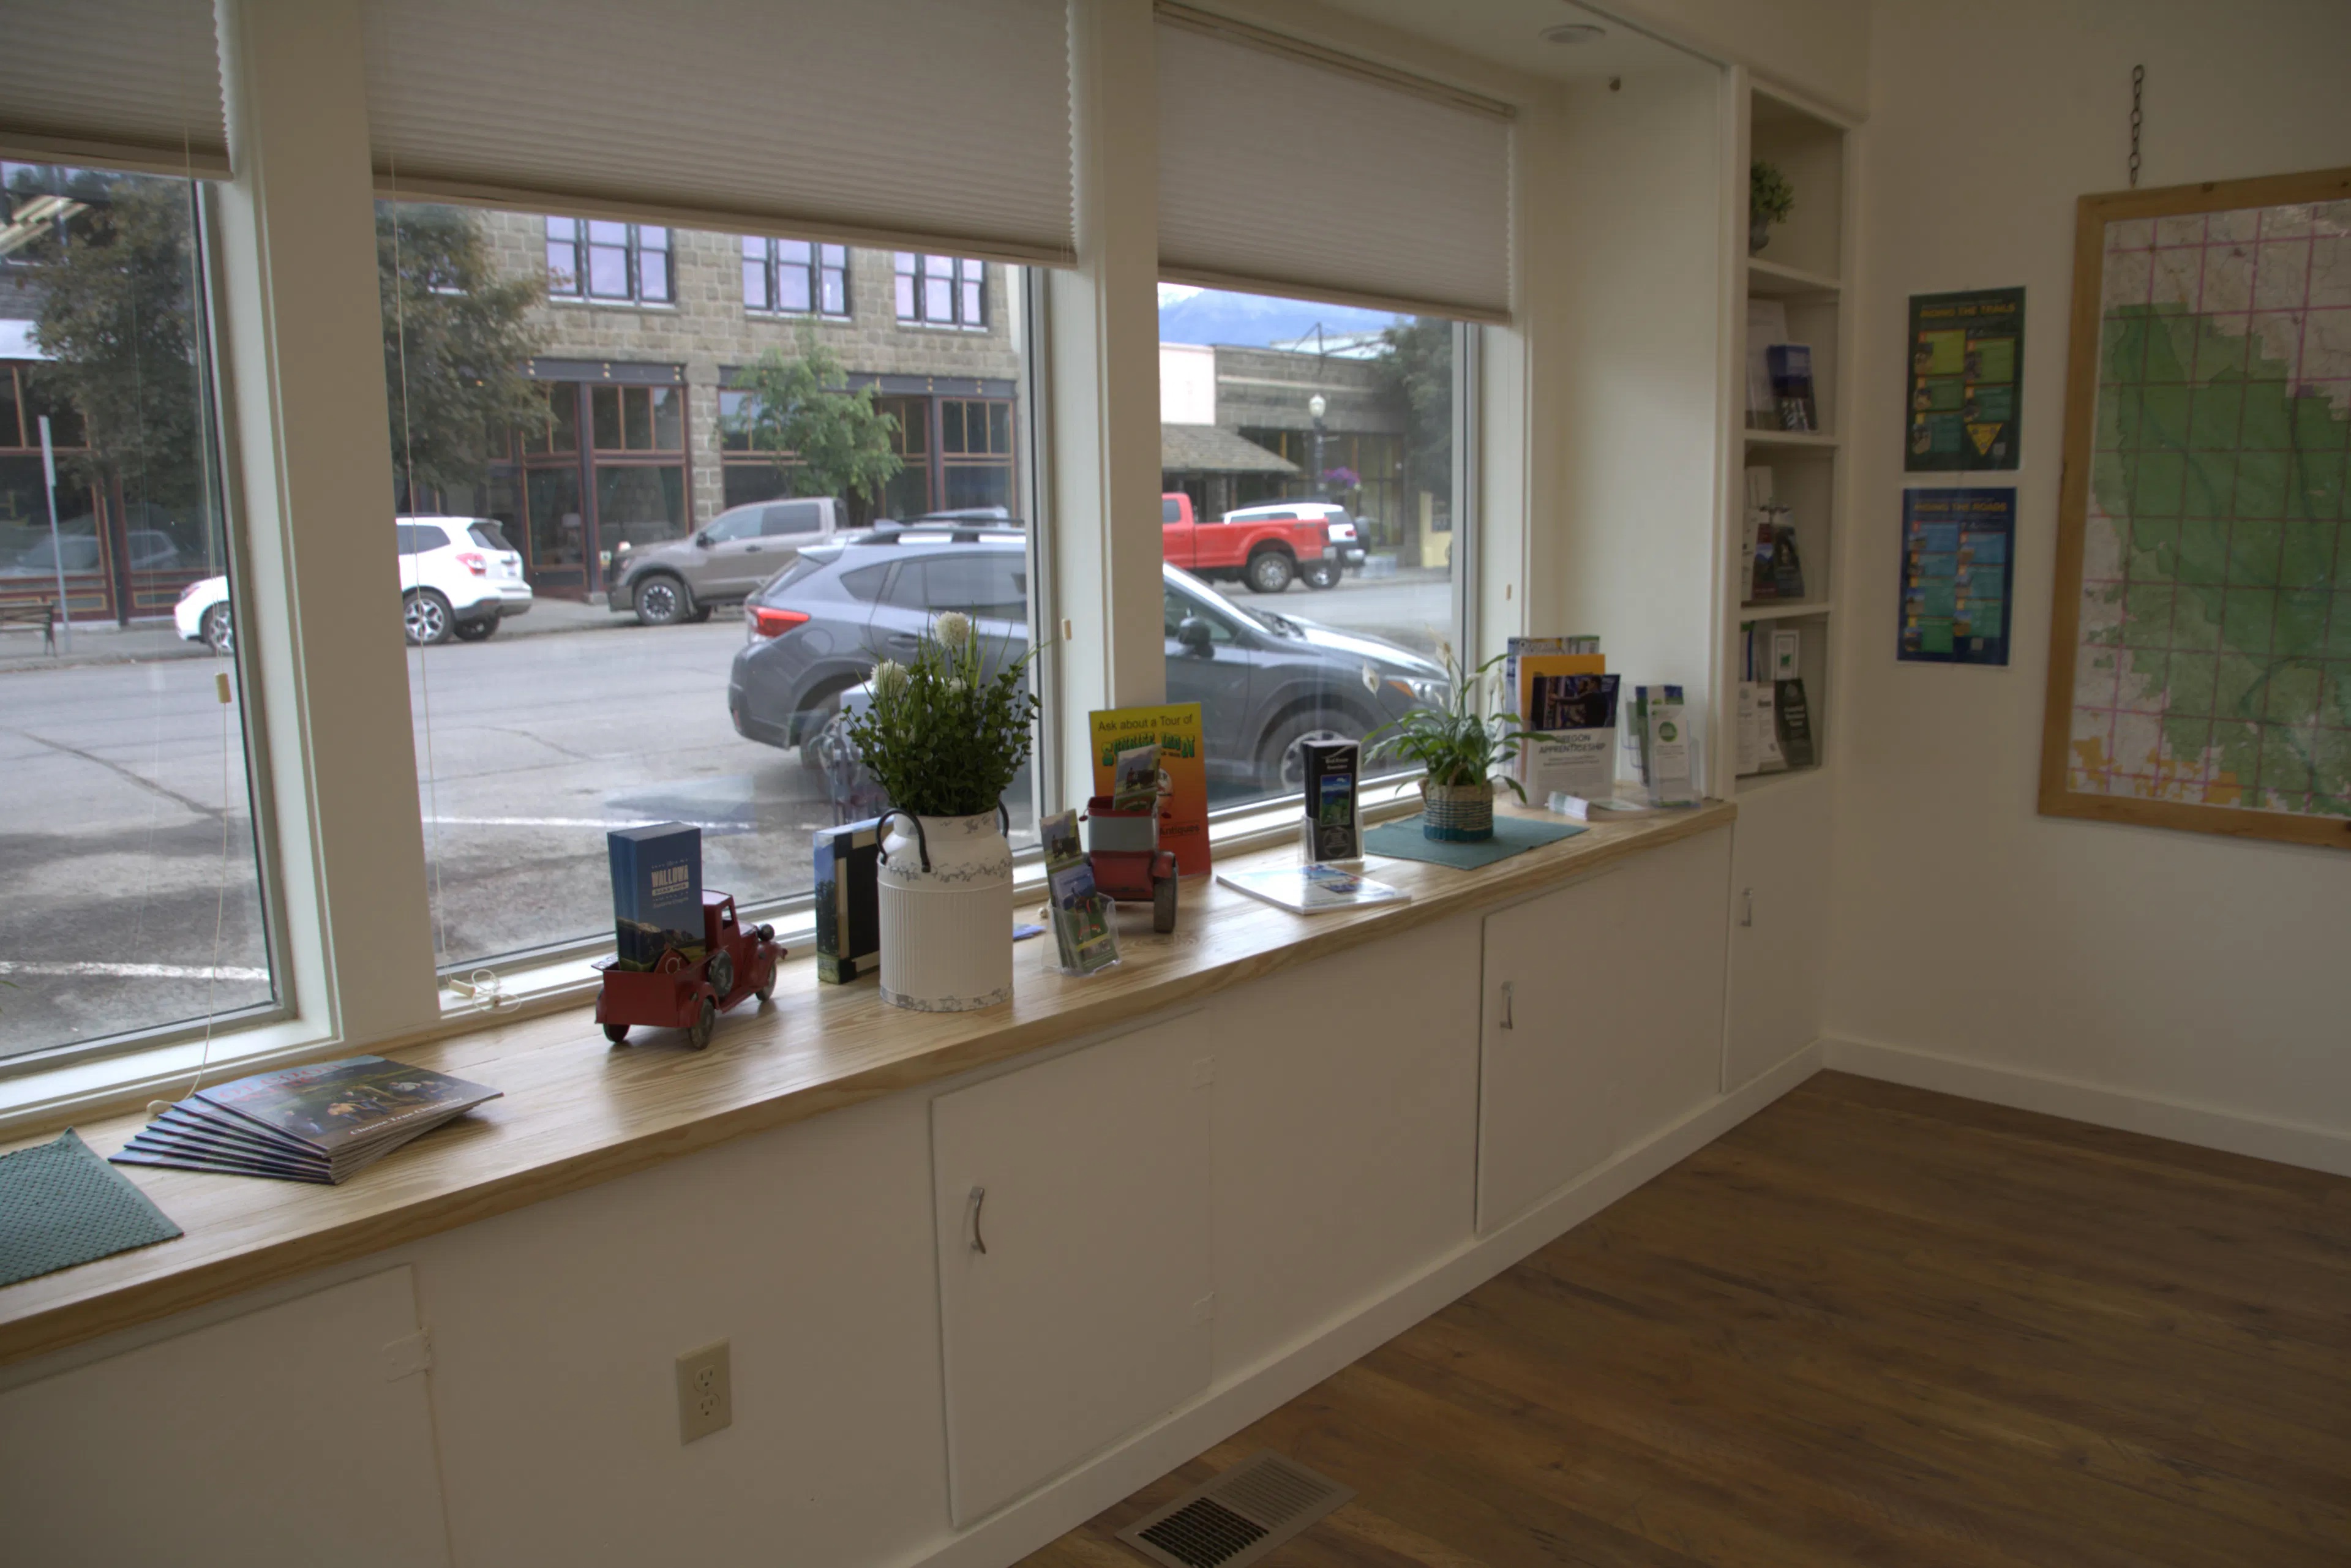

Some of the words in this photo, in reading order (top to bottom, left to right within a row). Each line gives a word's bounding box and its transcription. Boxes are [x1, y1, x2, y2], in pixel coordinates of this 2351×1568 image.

[1098, 720, 1117, 732] Ask
[1120, 718, 1149, 730] about
[1150, 719, 1157, 727] a
[1160, 715, 1180, 726] Tour
[1183, 713, 1193, 724] of
[651, 865, 689, 888] WALLOWA
[350, 1120, 389, 1136] Choose
[389, 1112, 414, 1123] True
